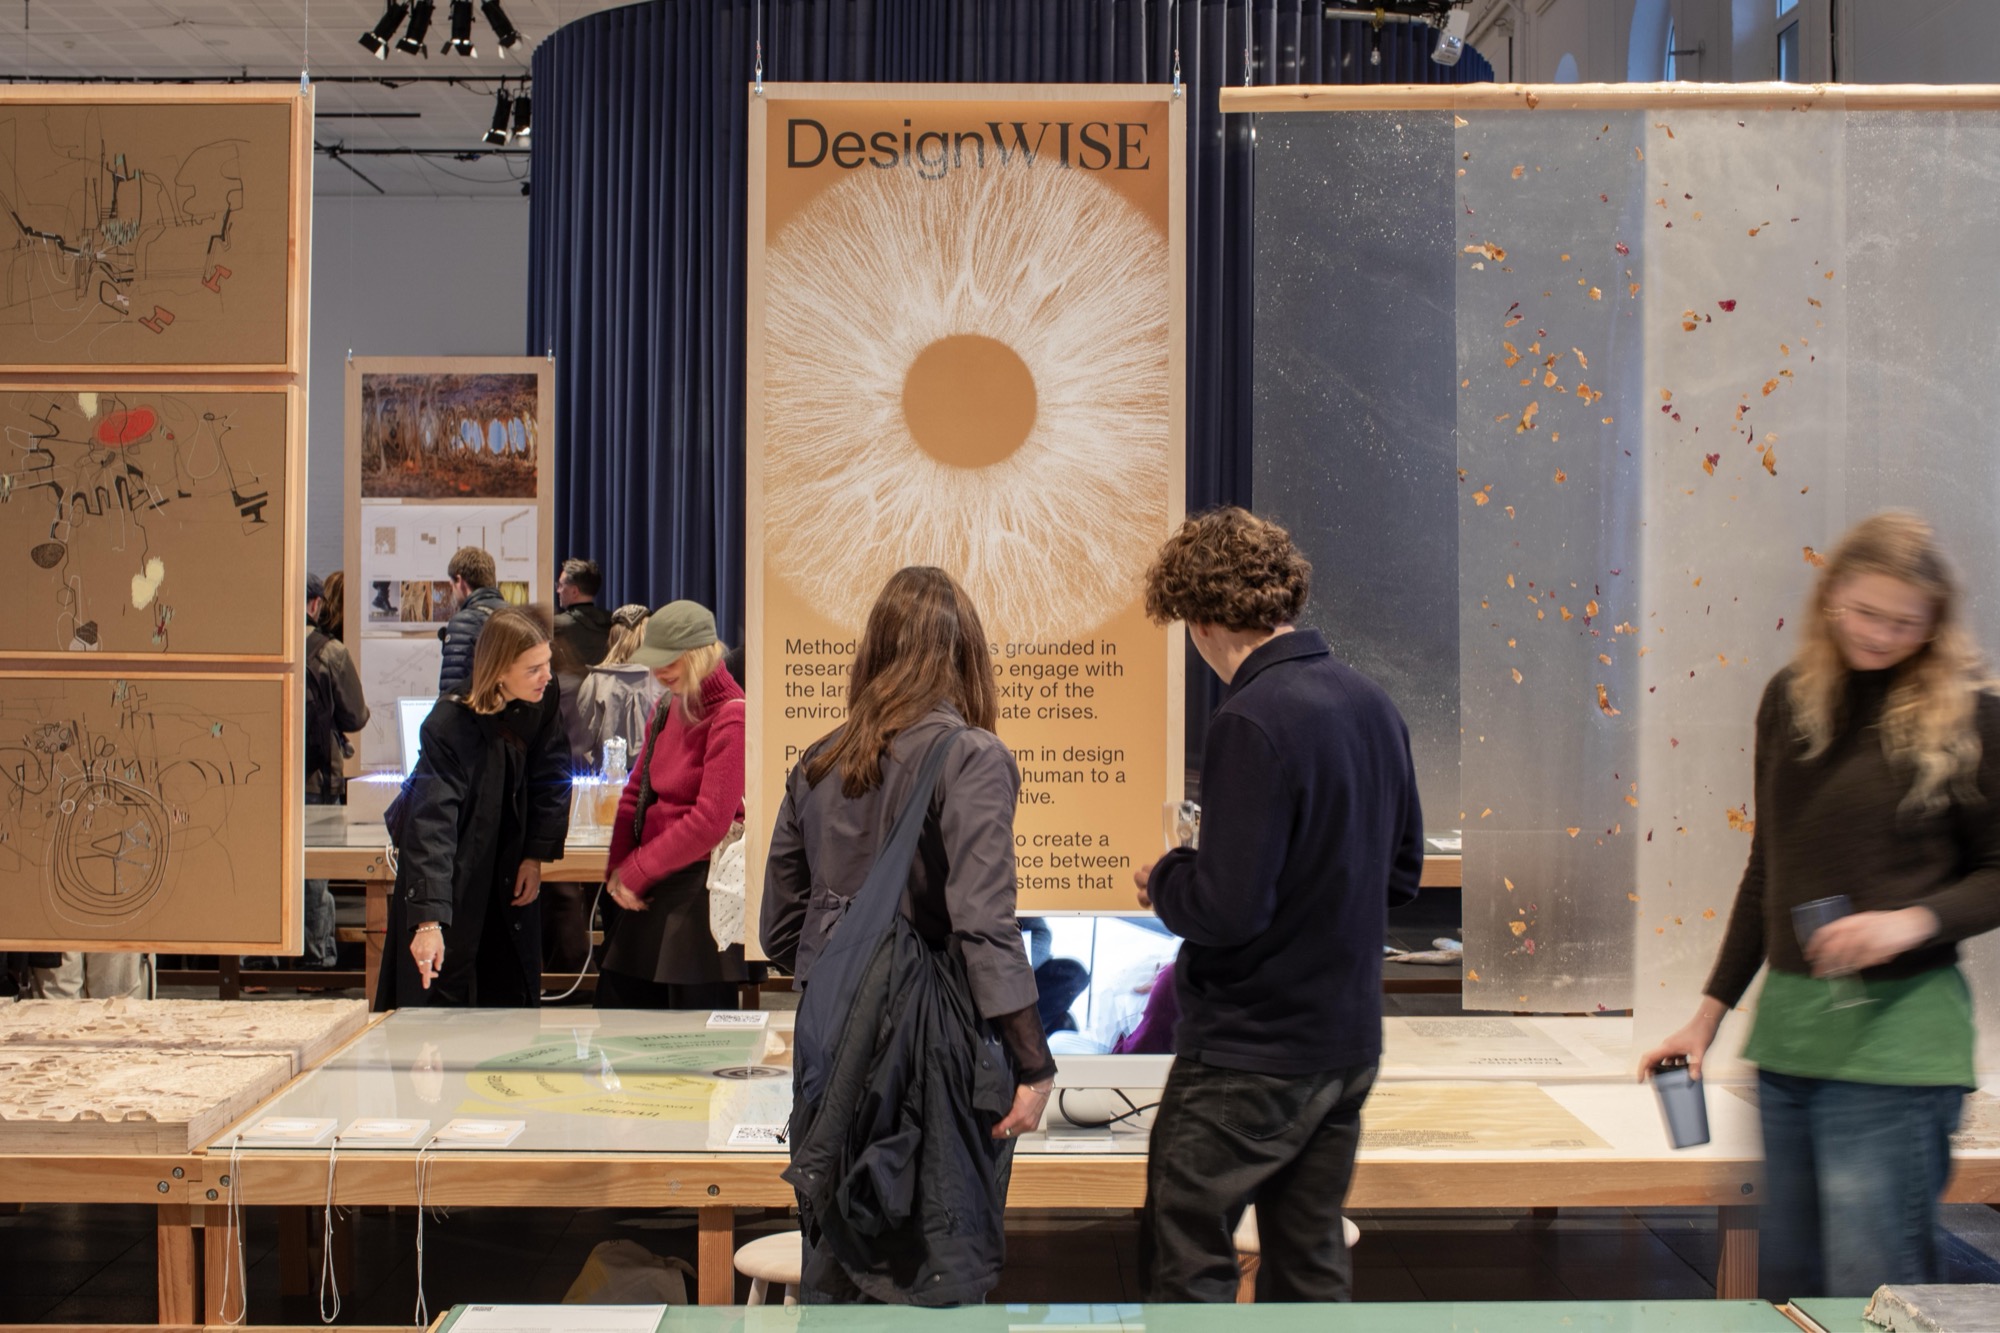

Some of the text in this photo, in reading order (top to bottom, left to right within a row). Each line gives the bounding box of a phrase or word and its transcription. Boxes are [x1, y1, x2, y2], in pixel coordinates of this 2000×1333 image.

[787, 118, 1150, 181] DesignWISE
[785, 639, 861, 655] Method
[1005, 640, 1095, 659] grounded
[1101, 640, 1116, 655] in
[785, 663, 853, 676] researc
[1009, 664, 1079, 681] engage
[1085, 661, 1124, 677] with
[785, 681, 815, 697] the
[1040, 682, 1058, 698] of
[1065, 682, 1095, 698] the
[1037, 703, 1098, 719] crises.
[1041, 746, 1056, 762] in
[1062, 746, 1125, 765] design
[1022, 767, 1126, 783] human to a
[1032, 832, 1093, 847] create
[1098, 834, 1110, 847] a
[1050, 852, 1130, 868] between
[1016, 873, 1114, 890] stems that
